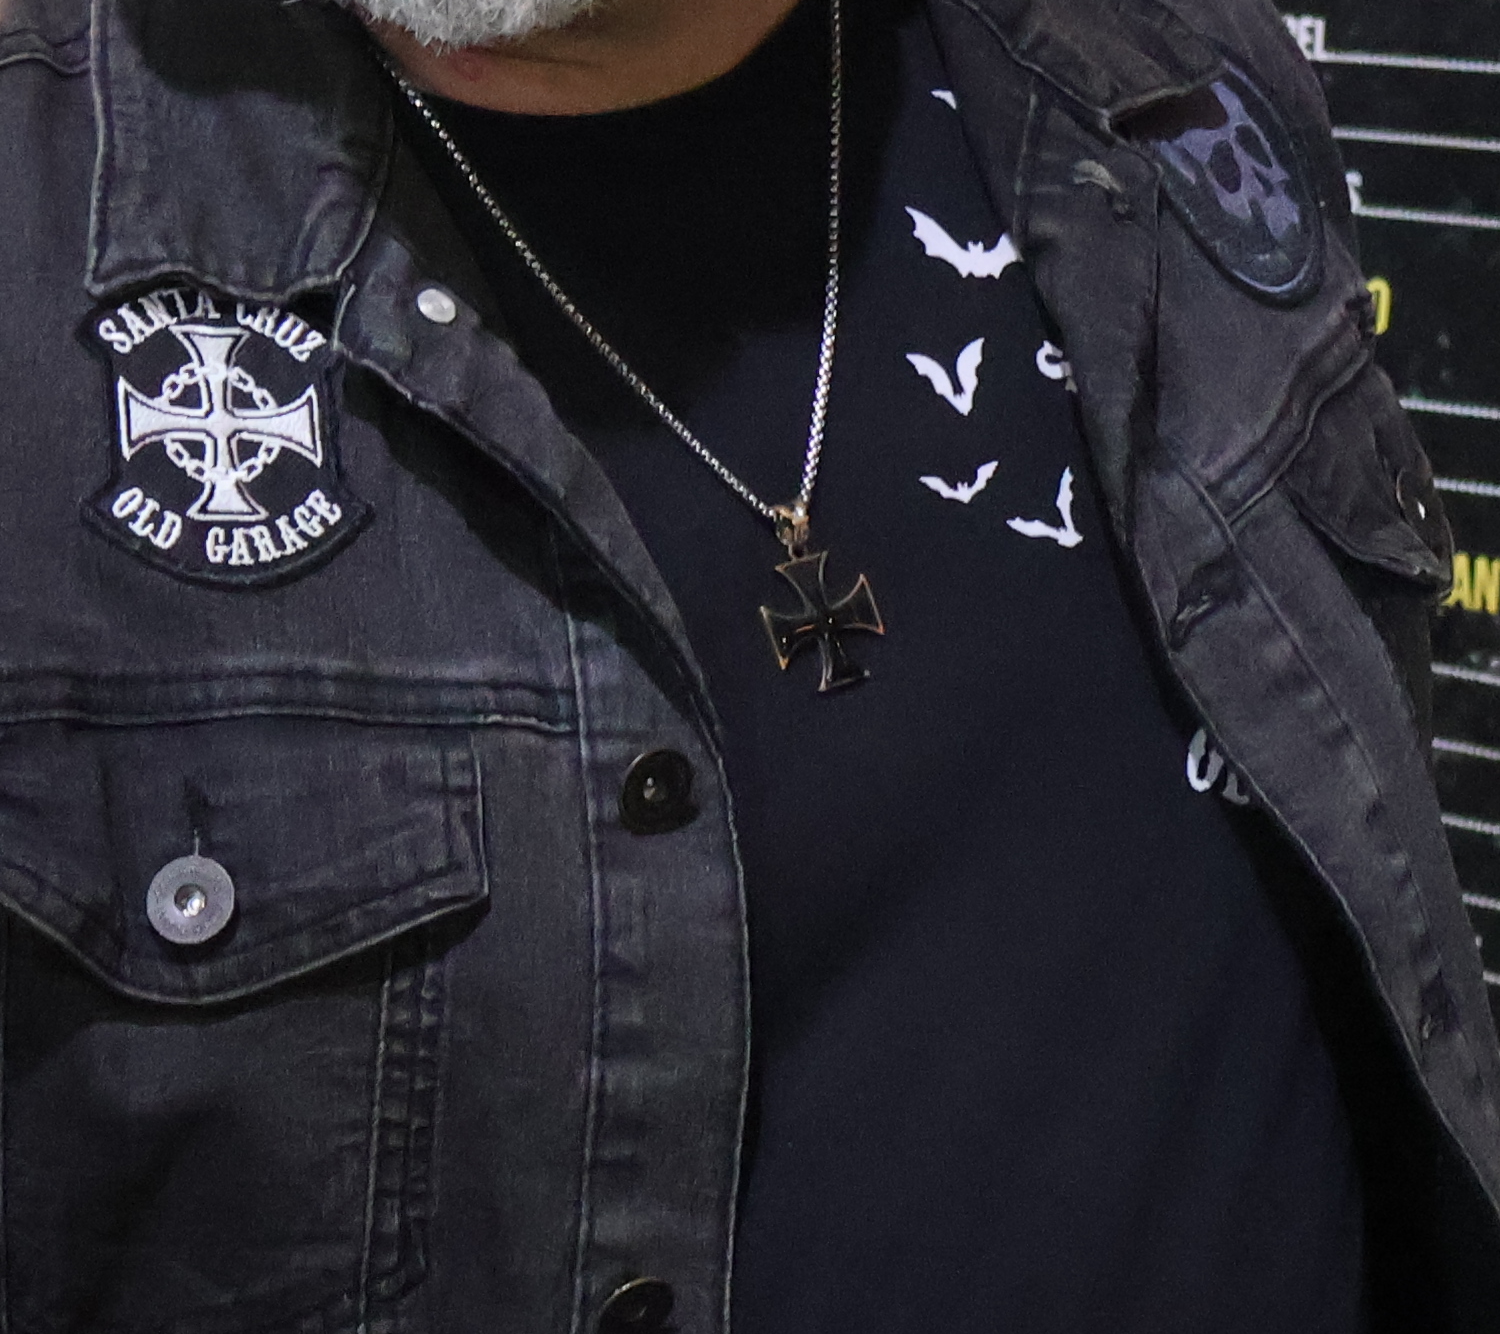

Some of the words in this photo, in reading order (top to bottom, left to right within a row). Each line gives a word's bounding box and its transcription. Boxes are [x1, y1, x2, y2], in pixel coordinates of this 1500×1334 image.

[99, 289, 221, 354] SANTA
[112, 487, 182, 550] OLD
[205, 489, 343, 566] GARAGE
